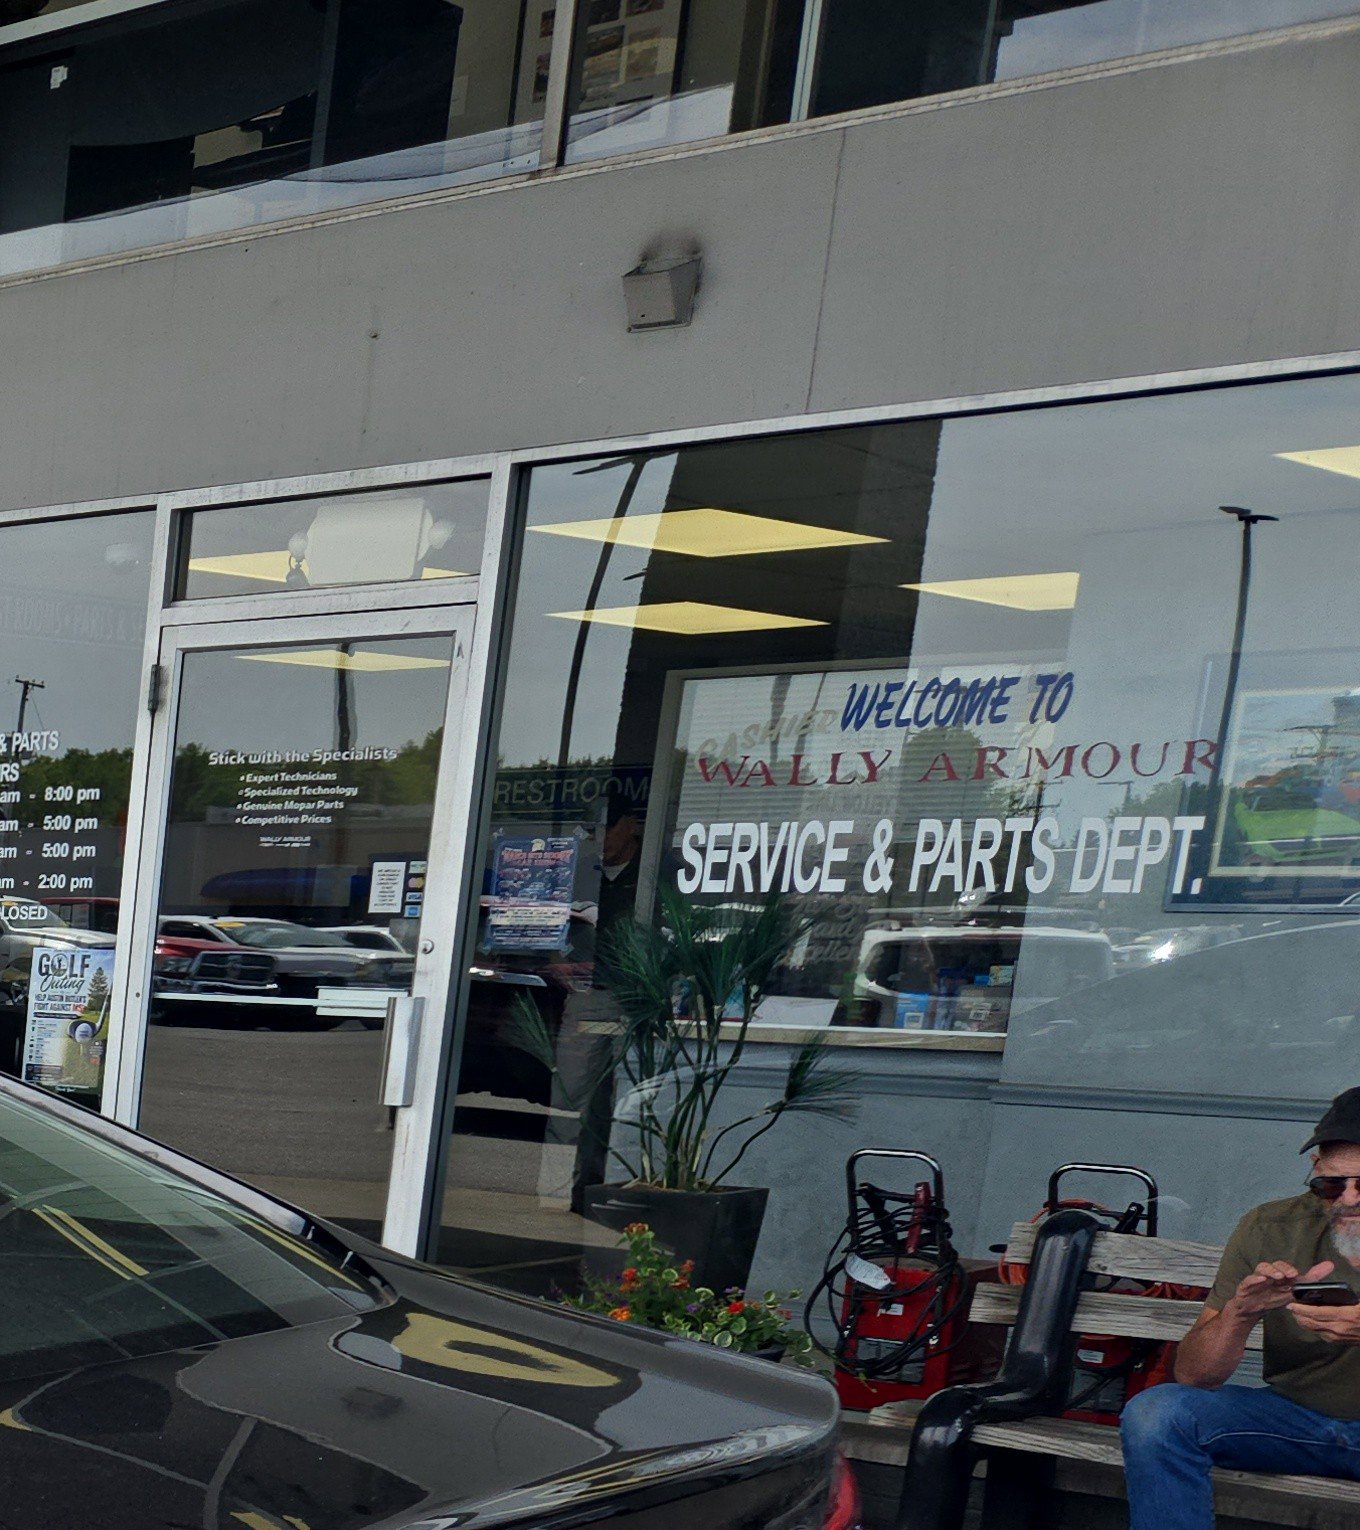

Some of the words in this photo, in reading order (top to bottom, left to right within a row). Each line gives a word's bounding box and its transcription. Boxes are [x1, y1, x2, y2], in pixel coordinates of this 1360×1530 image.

[841, 674, 1021, 732] WELCOME
[1029, 671, 1075, 725] TO
[11, 731, 60, 755] PARTS
[208, 751, 247, 766] Stick
[248, 750, 281, 764] with
[284, 749, 310, 763] the
[312, 746, 398, 765] Specialists
[698, 750, 892, 788] WALLY
[917, 738, 1220, 783] ARMOUR
[246, 773, 279, 784] Expert
[280, 771, 337, 782] Technicians
[0, 791, 21, 803] am
[44, 786, 73, 801] 8:00
[76, 787, 100, 804] pm
[244, 786, 300, 798] Specialized
[301, 785, 358, 797] Technology
[243, 801, 282, 810] Genuine
[283, 801, 315, 812] Mopar
[316, 799, 344, 809] Parts
[43, 815, 71, 830] 5:00
[75, 817, 98, 833] pm
[241, 815, 299, 826] Competitive
[300, 814, 332, 824] Prices
[41, 843, 69, 857] 5:00
[73, 844, 96, 860] pm
[678, 819, 854, 895] SERVICE
[863, 818, 894, 894] &
[909, 817, 1059, 893] PARTS
[1070, 815, 1206, 895] DEPT.
[38, 874, 66, 889] 2:00
[70, 875, 93, 892] pm
[38, 953, 91, 978] GOLF
[40, 974, 84, 994] Outing
